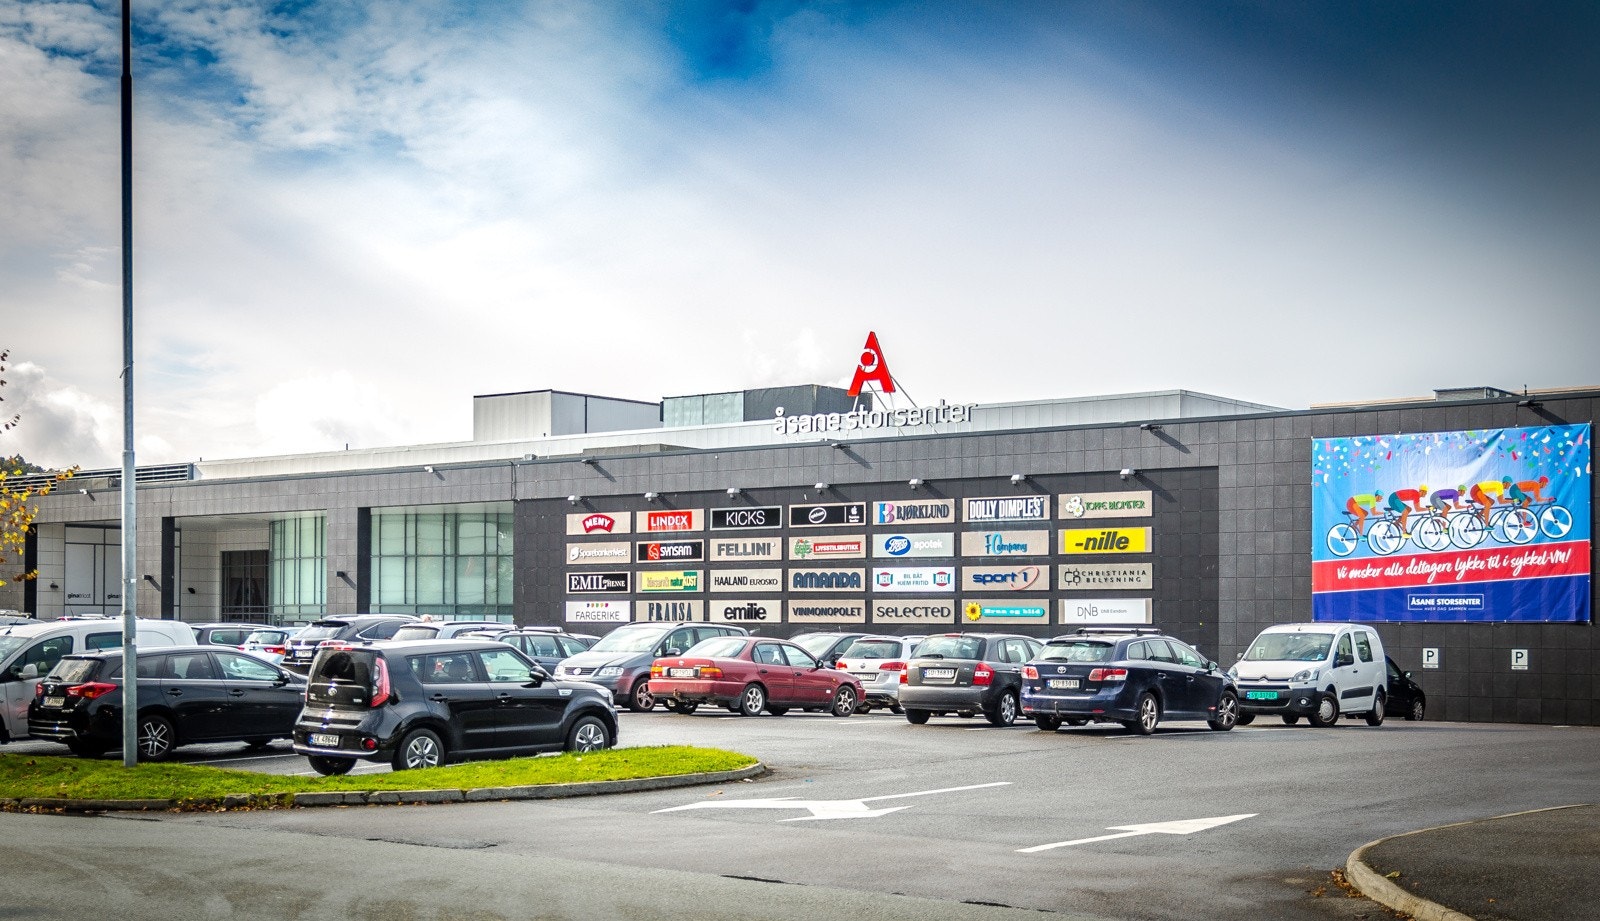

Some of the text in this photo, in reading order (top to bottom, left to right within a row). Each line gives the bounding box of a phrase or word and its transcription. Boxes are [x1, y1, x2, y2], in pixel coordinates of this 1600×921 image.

[774, 399, 977, 434] åsane storsenter
[896, 503, 949, 520] BJØRKLUND
[969, 500, 997, 519] DOLLY
[585, 516, 611, 529] MENY
[650, 515, 688, 527] LINDEX
[725, 510, 766, 526] KICKS
[913, 539, 943, 550] apotek
[1075, 531, 1129, 550] -nille
[660, 545, 692, 557] SYNSAM
[1081, 569, 1147, 577] CHRISTIANIA
[1337, 565, 1347, 580] Vi
[1383, 562, 1404, 576] alle
[1454, 555, 1486, 580] lykke
[1486, 554, 1501, 569] til
[1502, 555, 1509, 567] i
[570, 575, 607, 590] EMIL
[714, 576, 779, 586] HAALAND EUROSKO
[792, 572, 861, 589] AMANDA
[972, 572, 1018, 585] sport
[1410, 597, 1481, 606] ÅSANE STORSENTER
[575, 611, 620, 621] FARGERIKE
[647, 602, 693, 621] FRANSA
[724, 603, 767, 621] emilie
[792, 607, 862, 617] VINMONOPOLET
[1077, 603, 1099, 620] DNB
[1426, 650, 1435, 662] P
[1515, 651, 1524, 664] P
